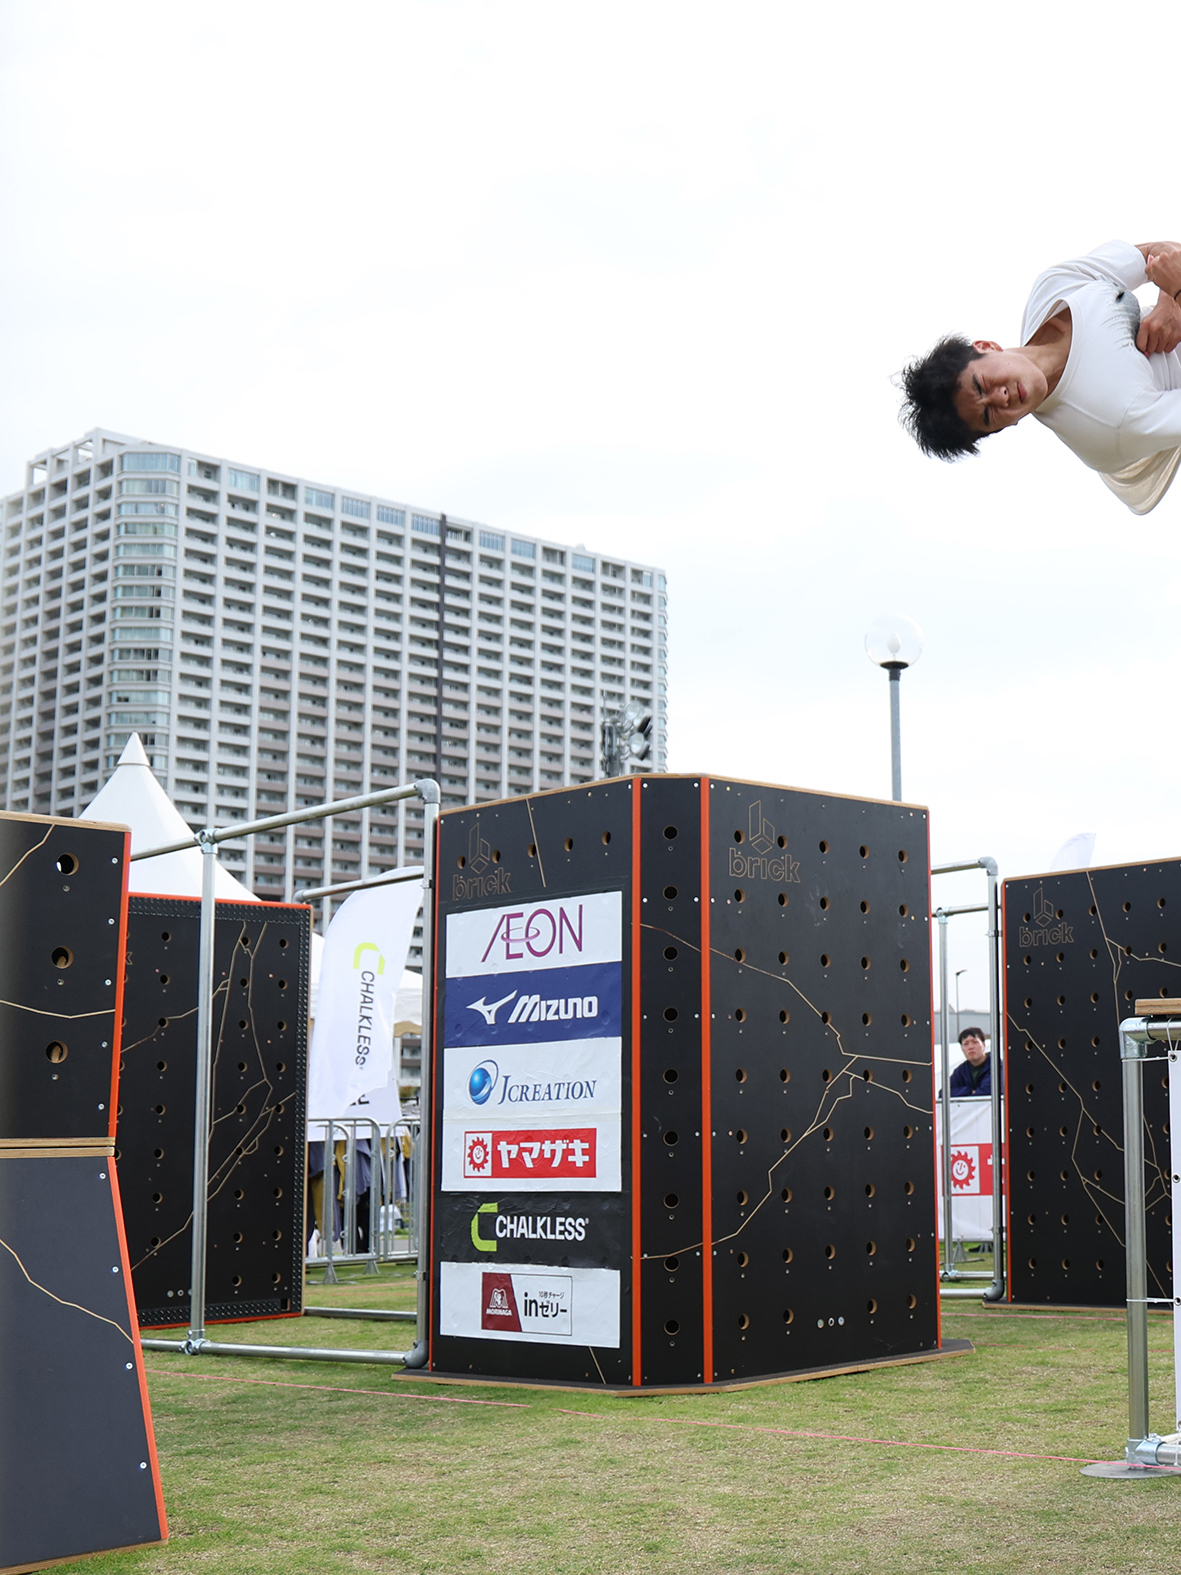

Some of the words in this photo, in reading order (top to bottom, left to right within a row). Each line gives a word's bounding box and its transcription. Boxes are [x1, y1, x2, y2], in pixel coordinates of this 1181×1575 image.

[729, 848, 801, 883] brick
[453, 868, 511, 901] brick
[1019, 922, 1074, 948] brick
[497, 1139, 590, 1168] ヤマザキ
